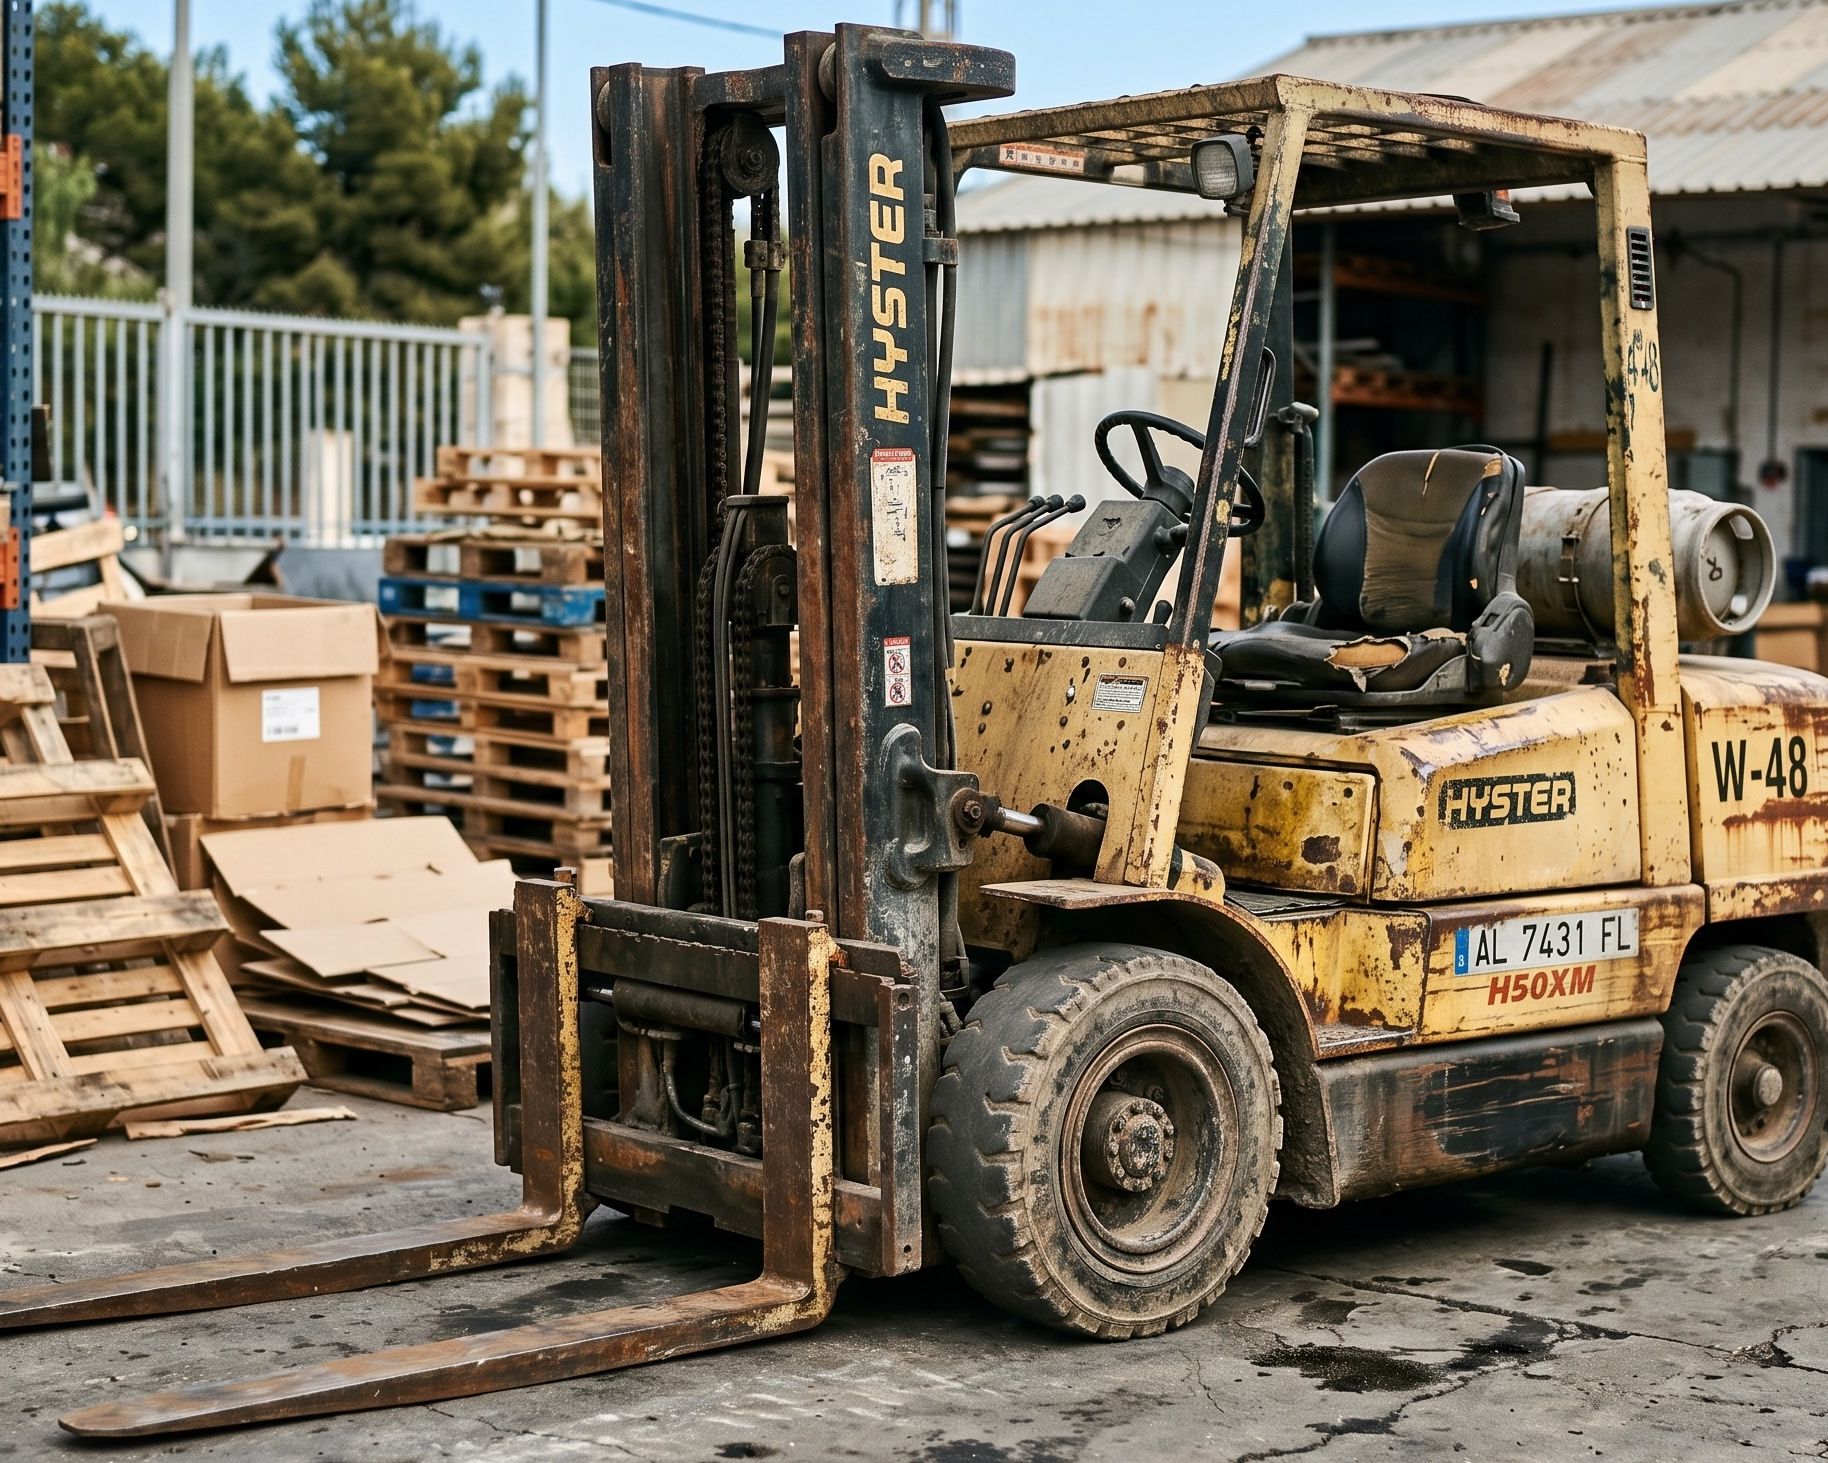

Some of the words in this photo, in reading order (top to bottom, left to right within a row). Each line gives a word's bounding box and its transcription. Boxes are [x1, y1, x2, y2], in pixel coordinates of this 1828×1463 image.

[869, 153, 909, 424] HYSTER
[1711, 735, 1808, 802] W-48
[1446, 779, 1572, 823] HYSTER
[1475, 929, 1508, 967] AL
[1522, 919, 1583, 962] 7431
[1602, 915, 1631, 952] FL
[1487, 965, 1597, 1006] H50XM
